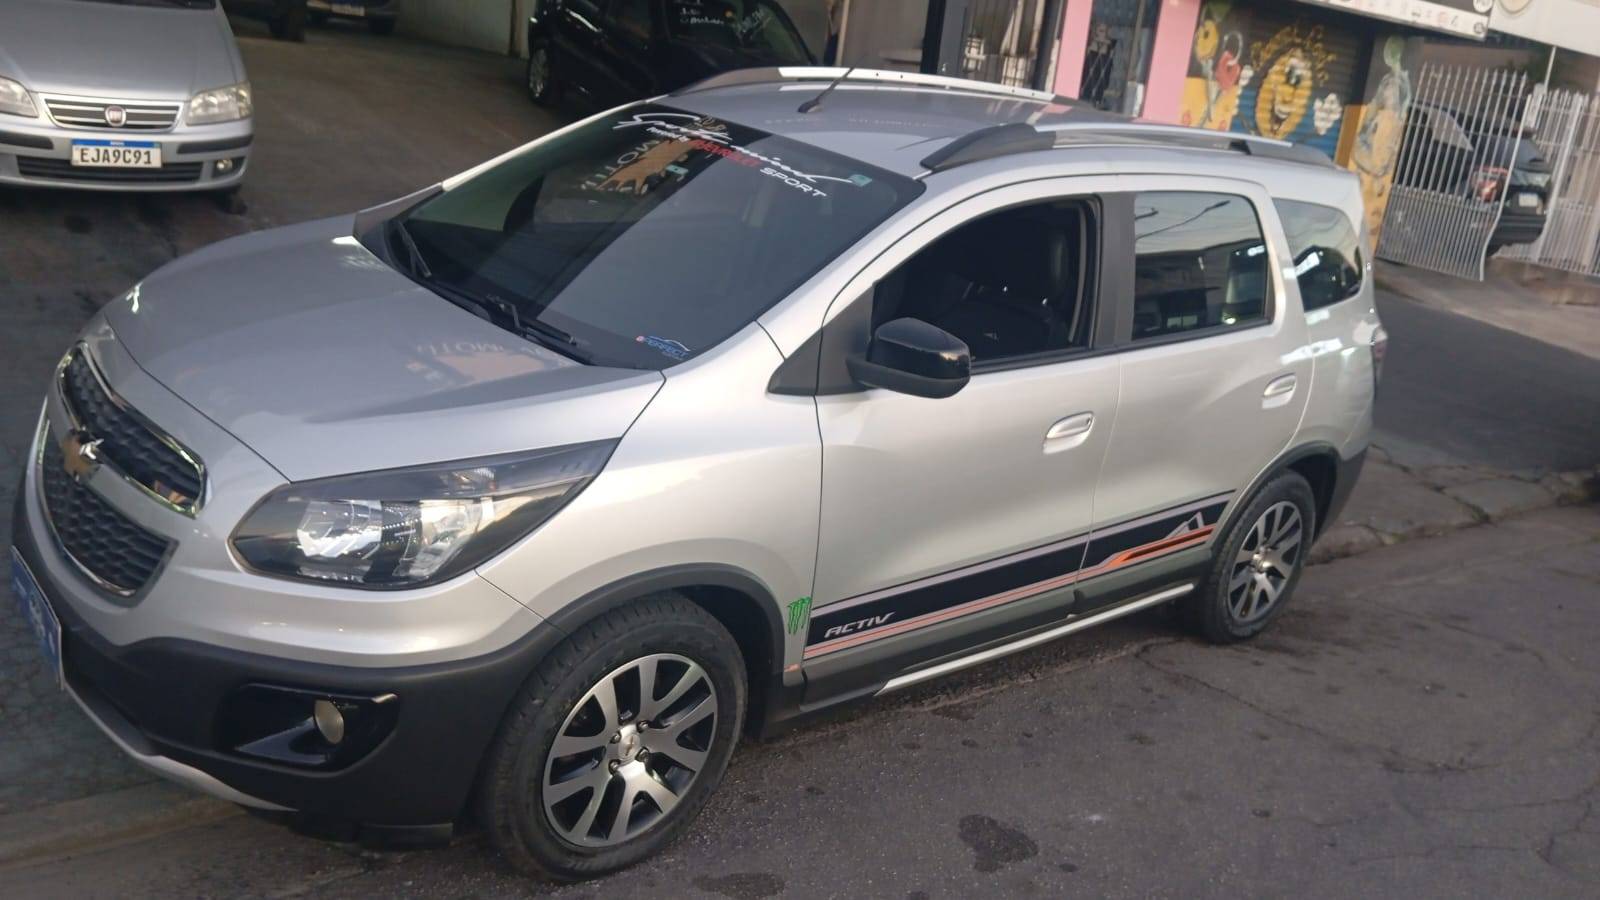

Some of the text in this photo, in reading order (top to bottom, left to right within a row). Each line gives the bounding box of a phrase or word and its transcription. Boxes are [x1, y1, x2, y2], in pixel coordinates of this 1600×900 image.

[80, 147, 152, 165] EJA9C91
[760, 166, 828, 197] SPORT
[824, 611, 896, 639] ACTIV
